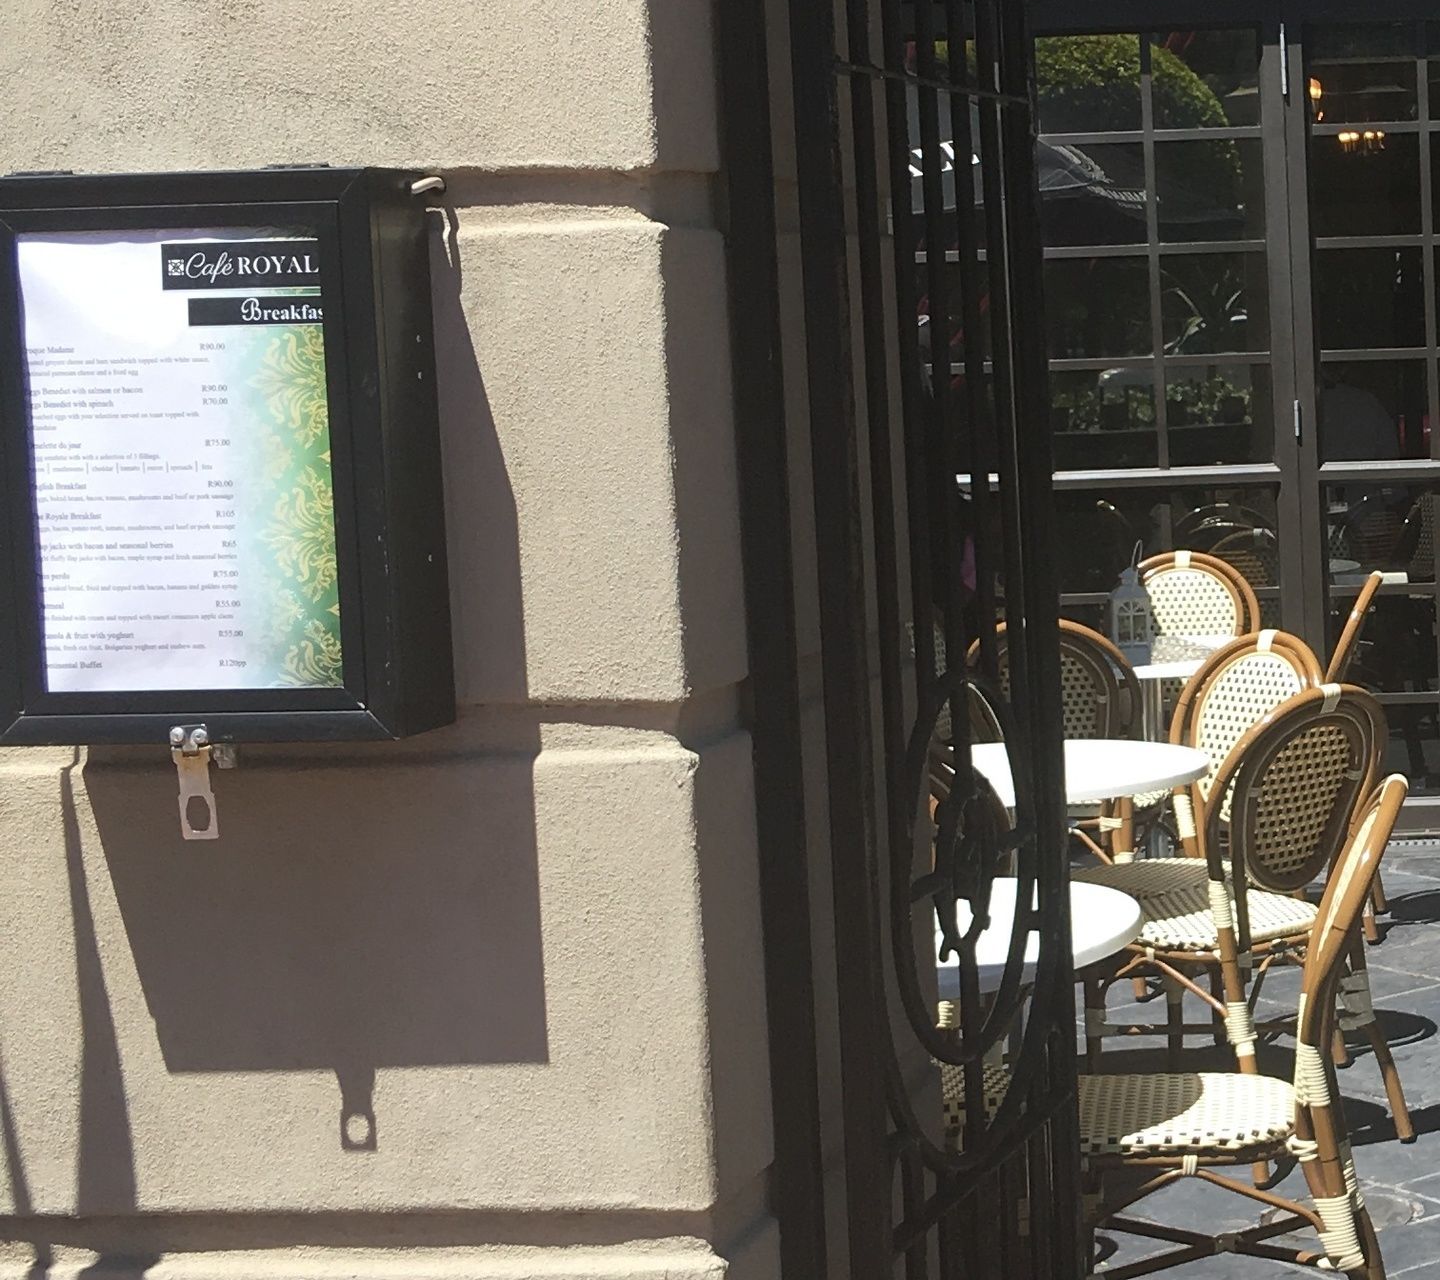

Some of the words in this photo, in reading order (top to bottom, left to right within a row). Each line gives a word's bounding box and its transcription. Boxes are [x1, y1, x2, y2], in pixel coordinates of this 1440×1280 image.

[185, 251, 234, 284] Café
[237, 255, 319, 274] ROYAL
[241, 297, 323, 321] Breakfas
